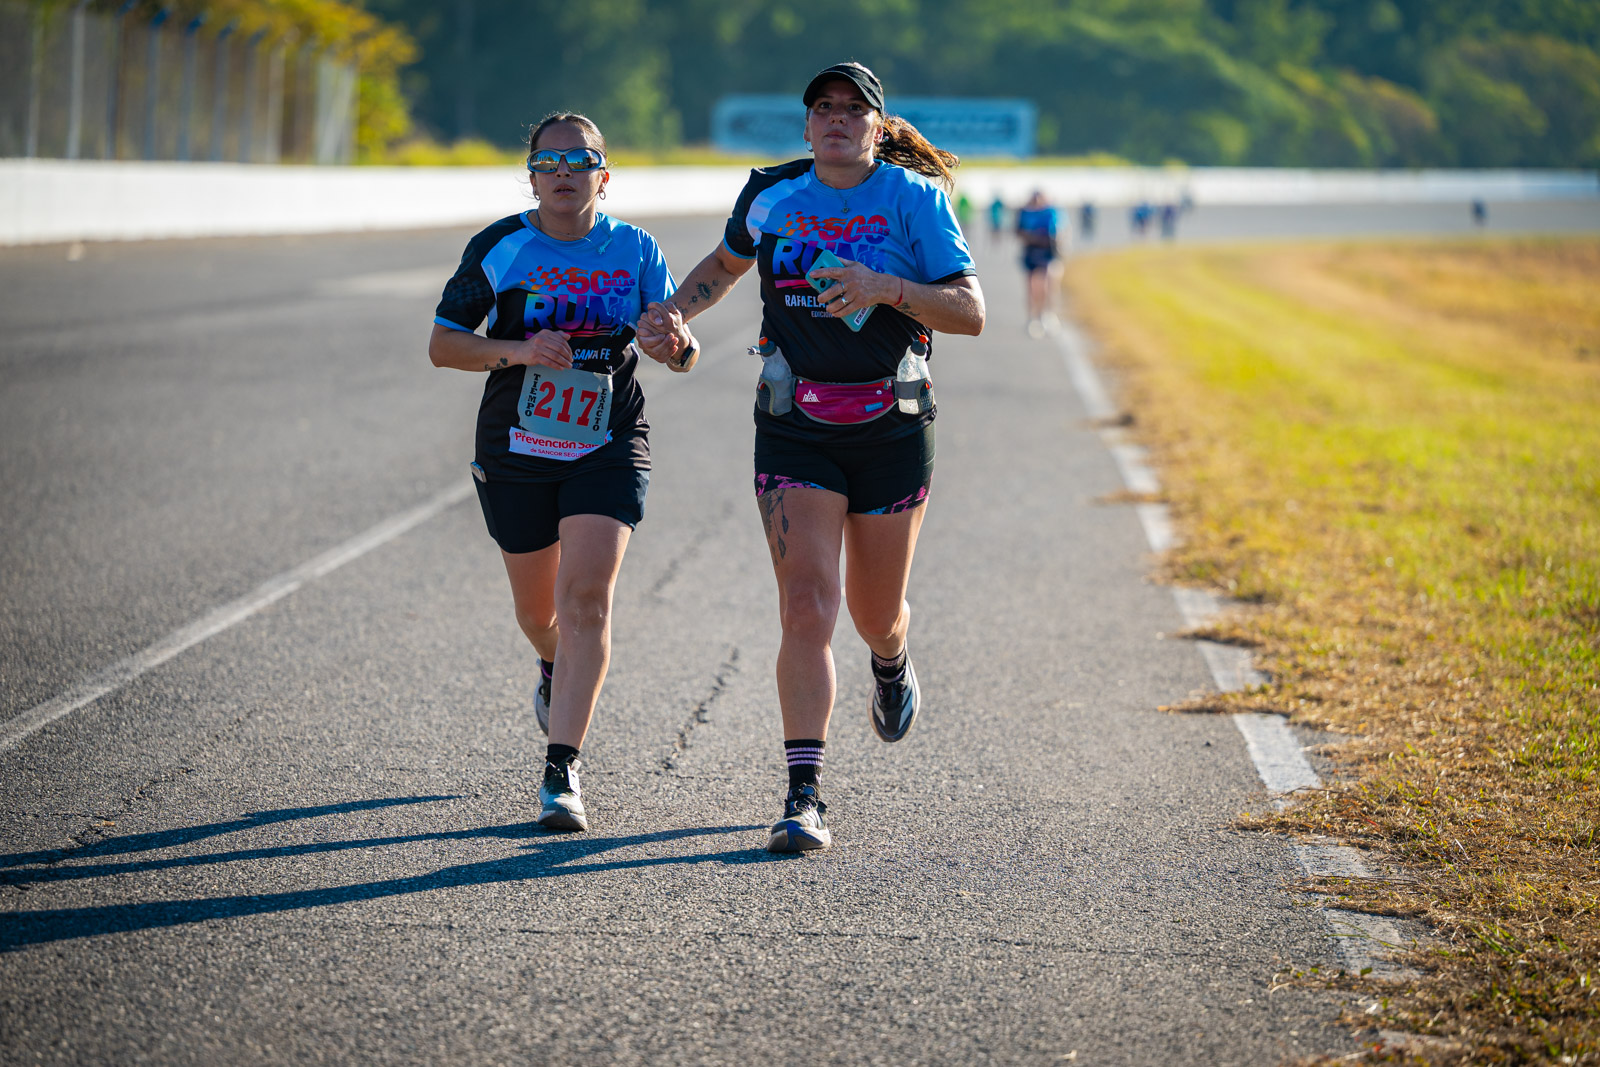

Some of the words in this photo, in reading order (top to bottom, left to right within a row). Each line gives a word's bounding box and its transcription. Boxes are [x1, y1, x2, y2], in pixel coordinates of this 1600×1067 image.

[818, 215, 888, 244] 500
[856, 225, 891, 236] MILLAS
[566, 268, 632, 296] 500
[603, 278, 636, 287] MILLAS
[600, 347, 612, 360] FE
[525, 373, 541, 417] TIEMPO
[533, 381, 599, 427] 217
[592, 388, 608, 432] EXACTO
[514, 431, 577, 449] Prevención
[537, 448, 563, 457] SANCOR
